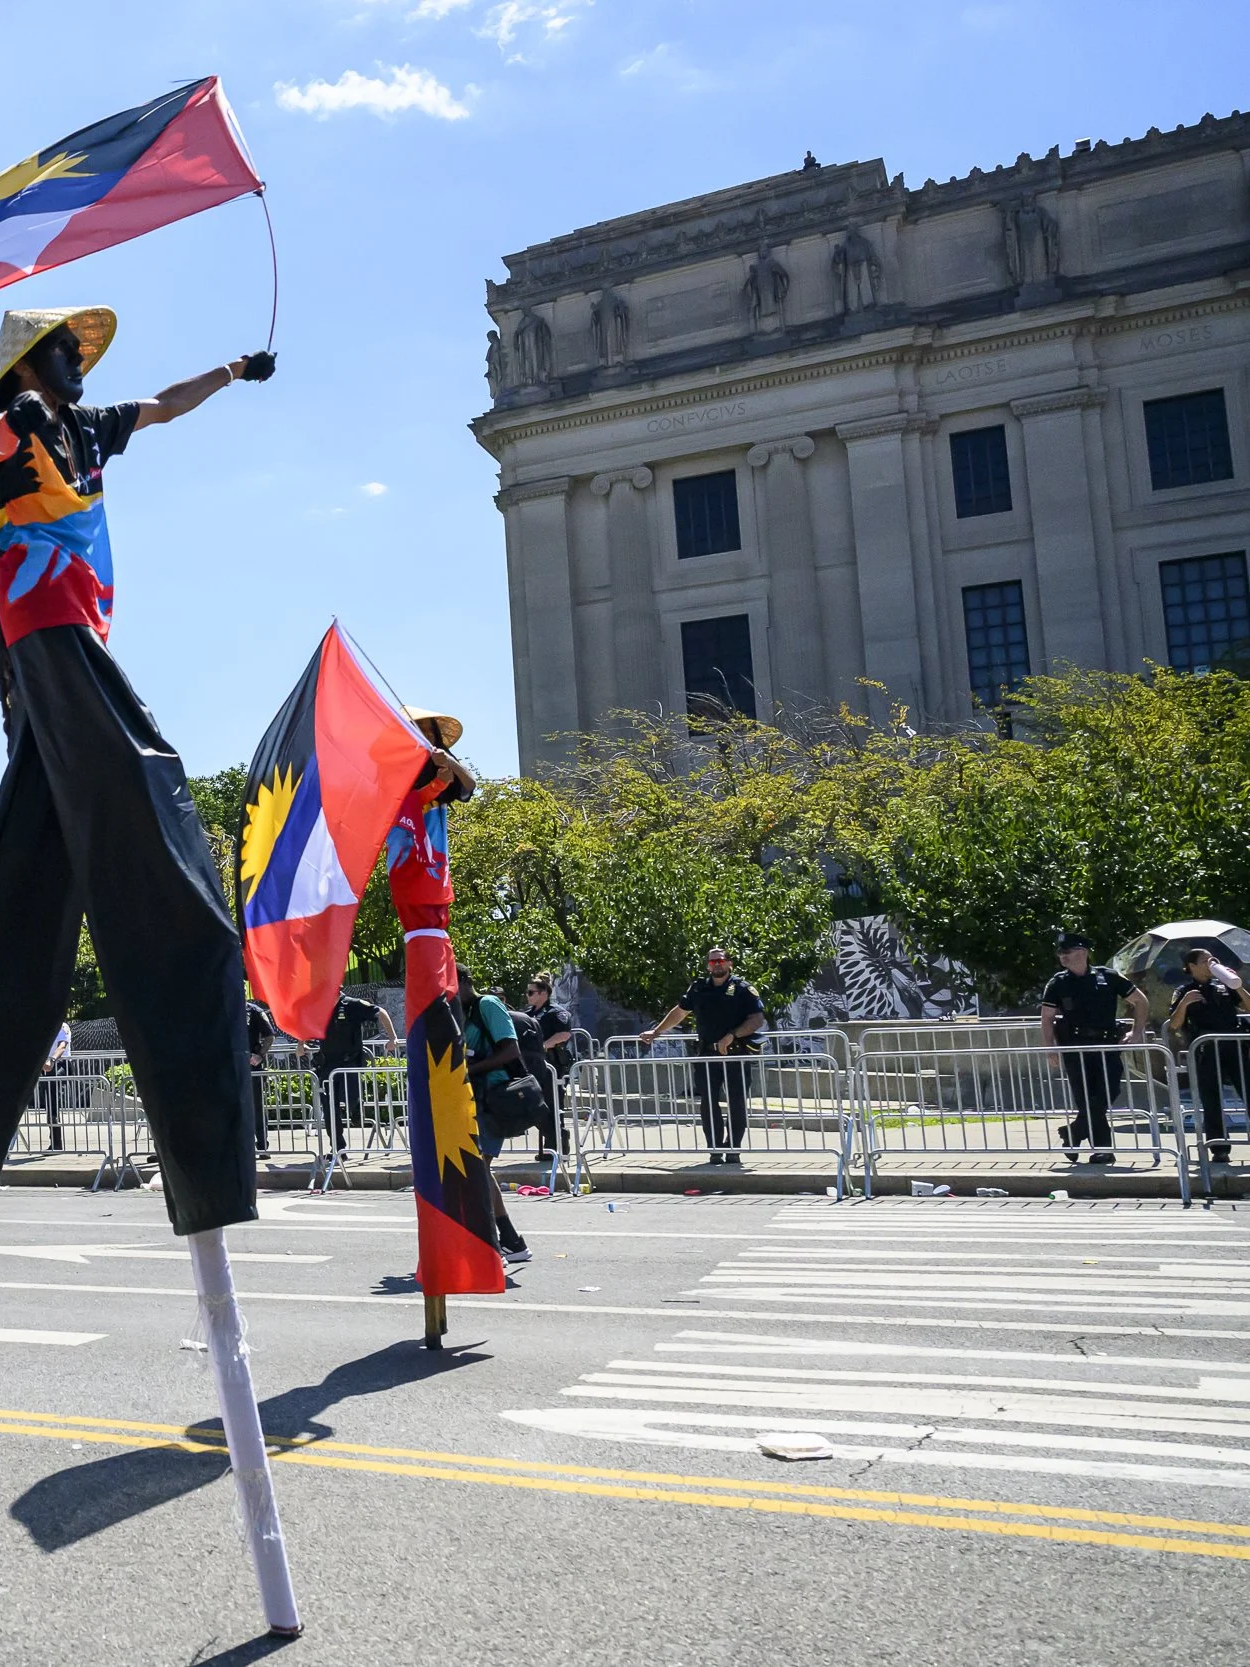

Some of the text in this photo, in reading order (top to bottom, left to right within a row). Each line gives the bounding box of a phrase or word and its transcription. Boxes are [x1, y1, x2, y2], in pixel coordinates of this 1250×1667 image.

[1139, 325, 1211, 351] MOSES
[936, 358, 1006, 385] LAOTSE
[647, 402, 746, 432] CONFVCIVS
